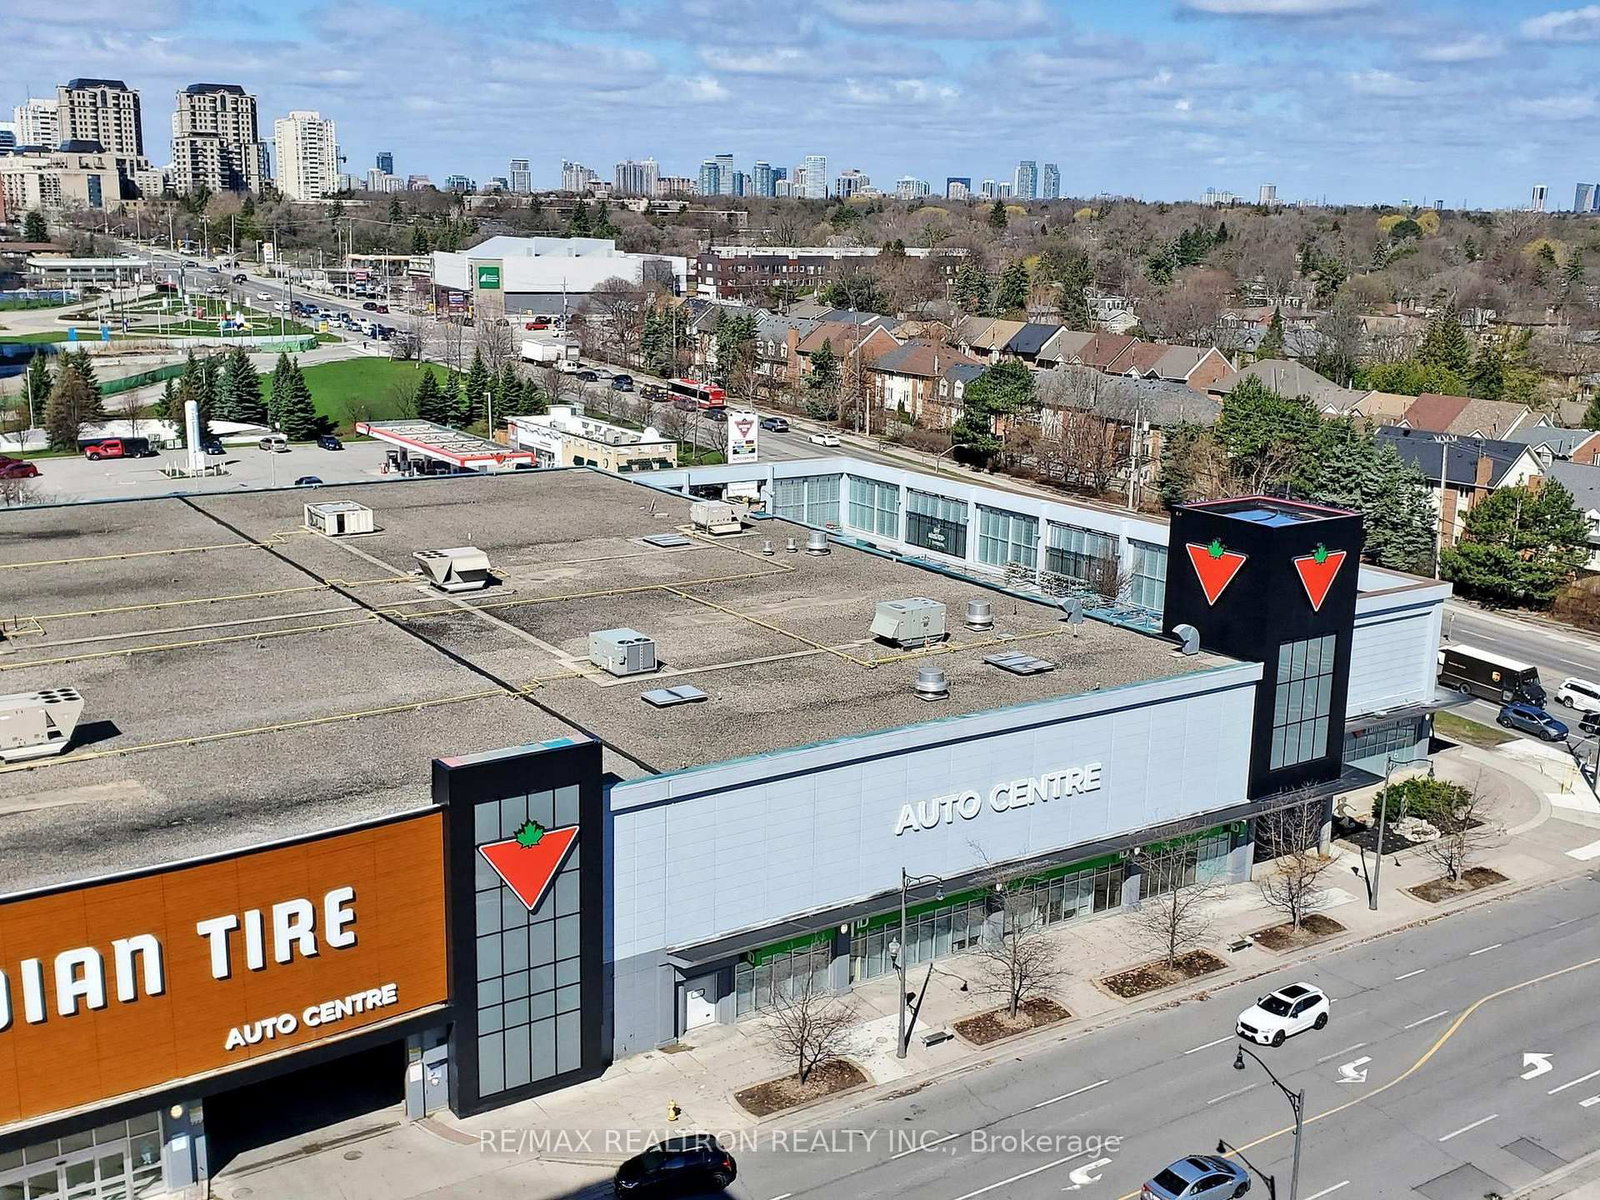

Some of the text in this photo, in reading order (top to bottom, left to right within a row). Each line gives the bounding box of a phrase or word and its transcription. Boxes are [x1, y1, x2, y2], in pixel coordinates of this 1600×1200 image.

[895, 763, 1102, 836] AUTO CENTRE
[0, 886, 357, 1031] IAN TIRE
[224, 983, 399, 1051] AUTO CENTRE
